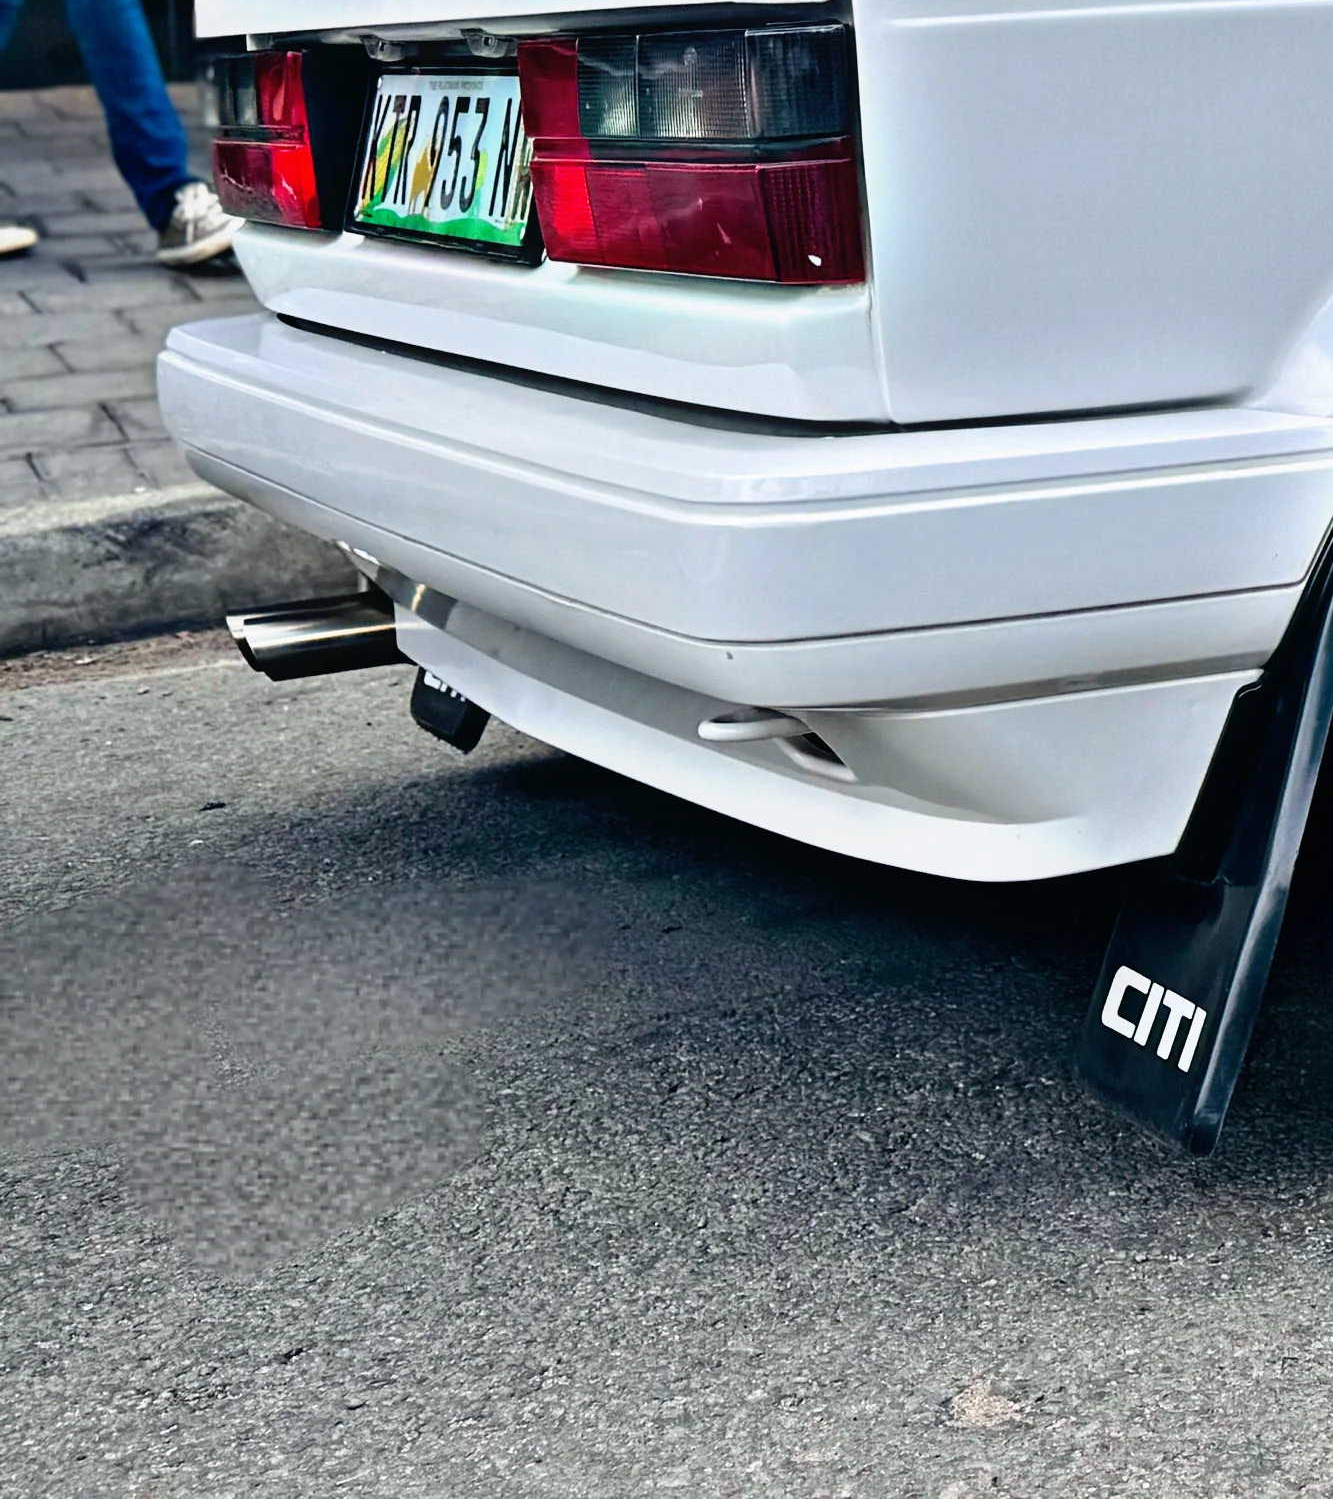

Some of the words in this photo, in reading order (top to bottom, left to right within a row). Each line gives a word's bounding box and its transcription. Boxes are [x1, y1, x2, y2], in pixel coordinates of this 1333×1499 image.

[362, 94, 422, 205] KTR
[424, 95, 491, 214] 953
[1101, 965, 1207, 1073] CITI
